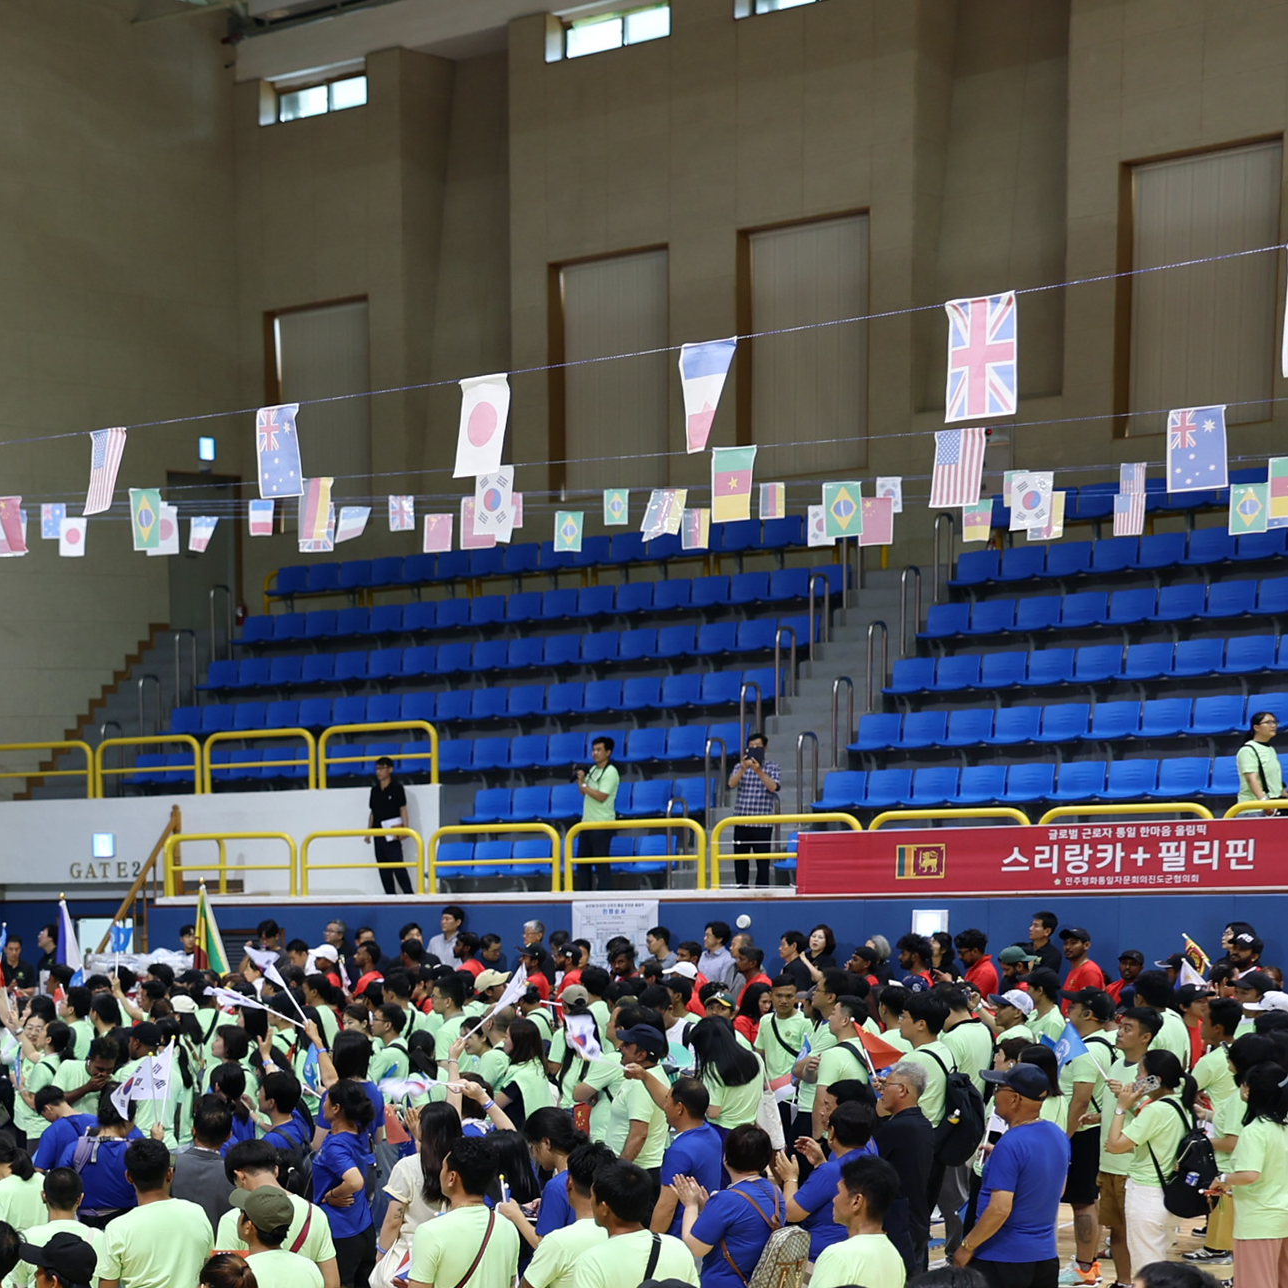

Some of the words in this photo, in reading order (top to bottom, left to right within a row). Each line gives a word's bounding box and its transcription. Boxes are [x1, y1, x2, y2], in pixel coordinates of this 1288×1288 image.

[1047, 829, 1078, 840] 글로벌
[1081, 827, 1113, 839] 근로자
[1116, 826, 1136, 839] 통일
[1140, 825, 1172, 838] 한마음
[1175, 824, 1207, 837] 올림픽
[69, 861, 129, 879] GATE
